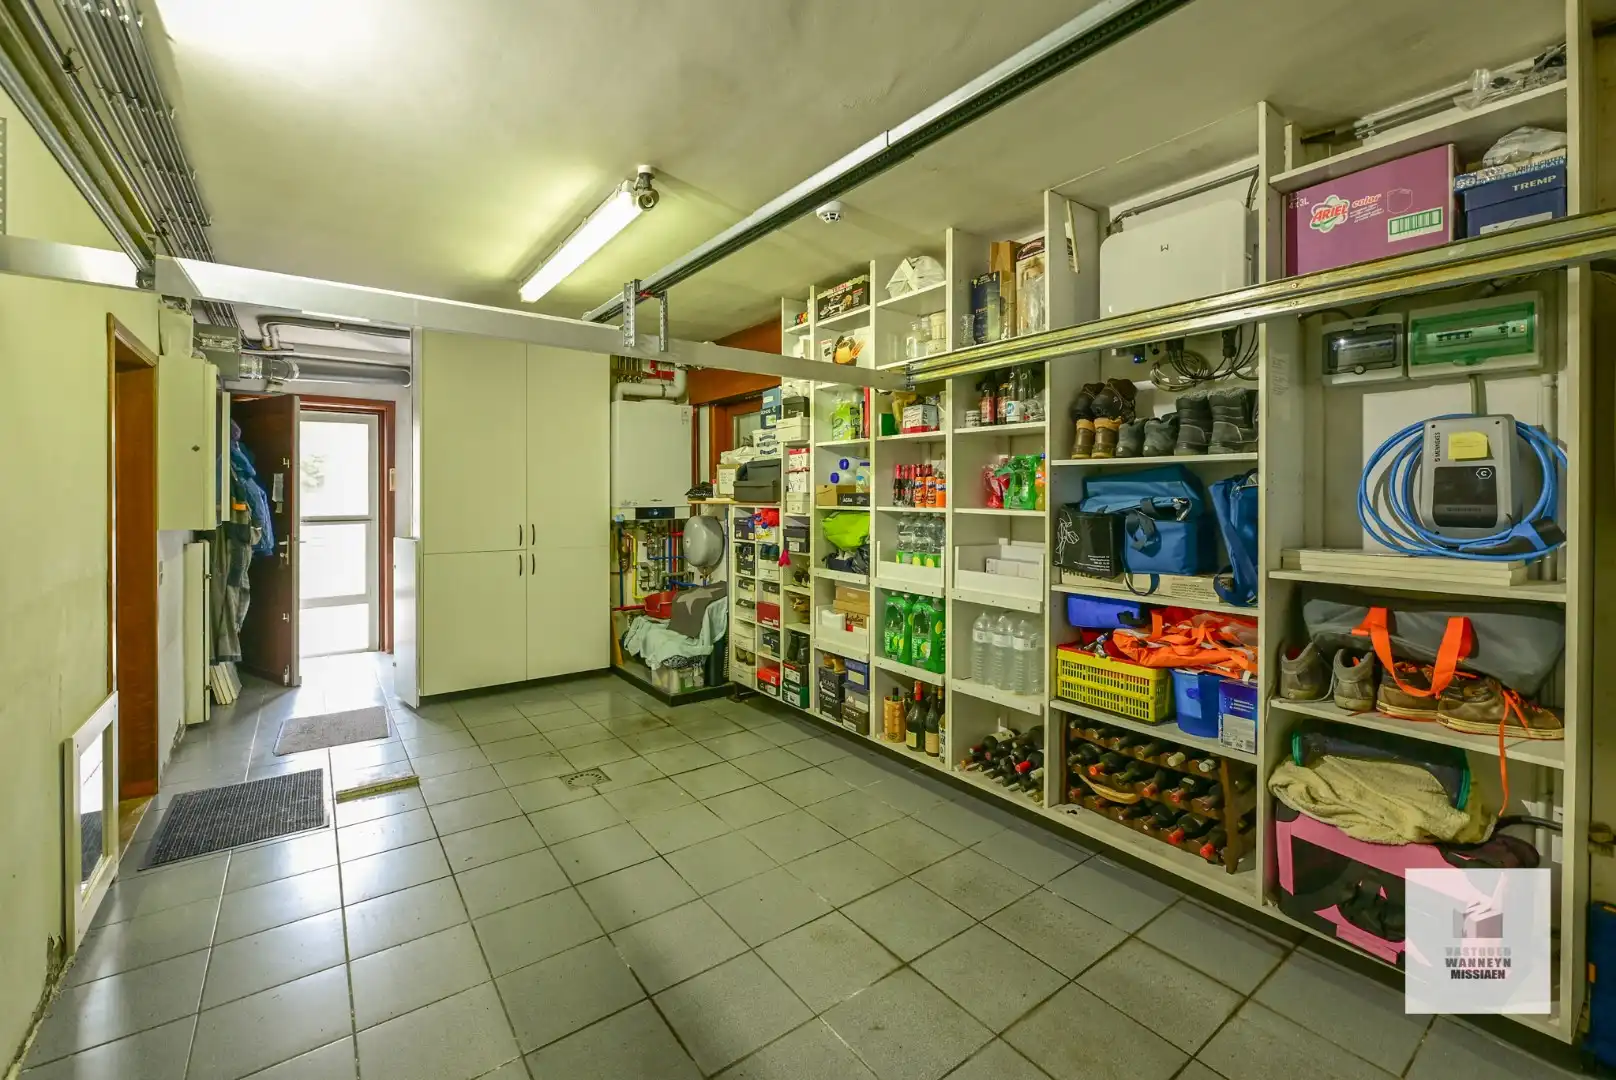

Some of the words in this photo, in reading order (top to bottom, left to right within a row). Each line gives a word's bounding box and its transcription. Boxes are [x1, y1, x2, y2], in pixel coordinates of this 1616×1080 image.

[1511, 175, 1557, 191] TREMP
[1351, 193, 1382, 208] color
[1312, 203, 1348, 223] ARIEL
